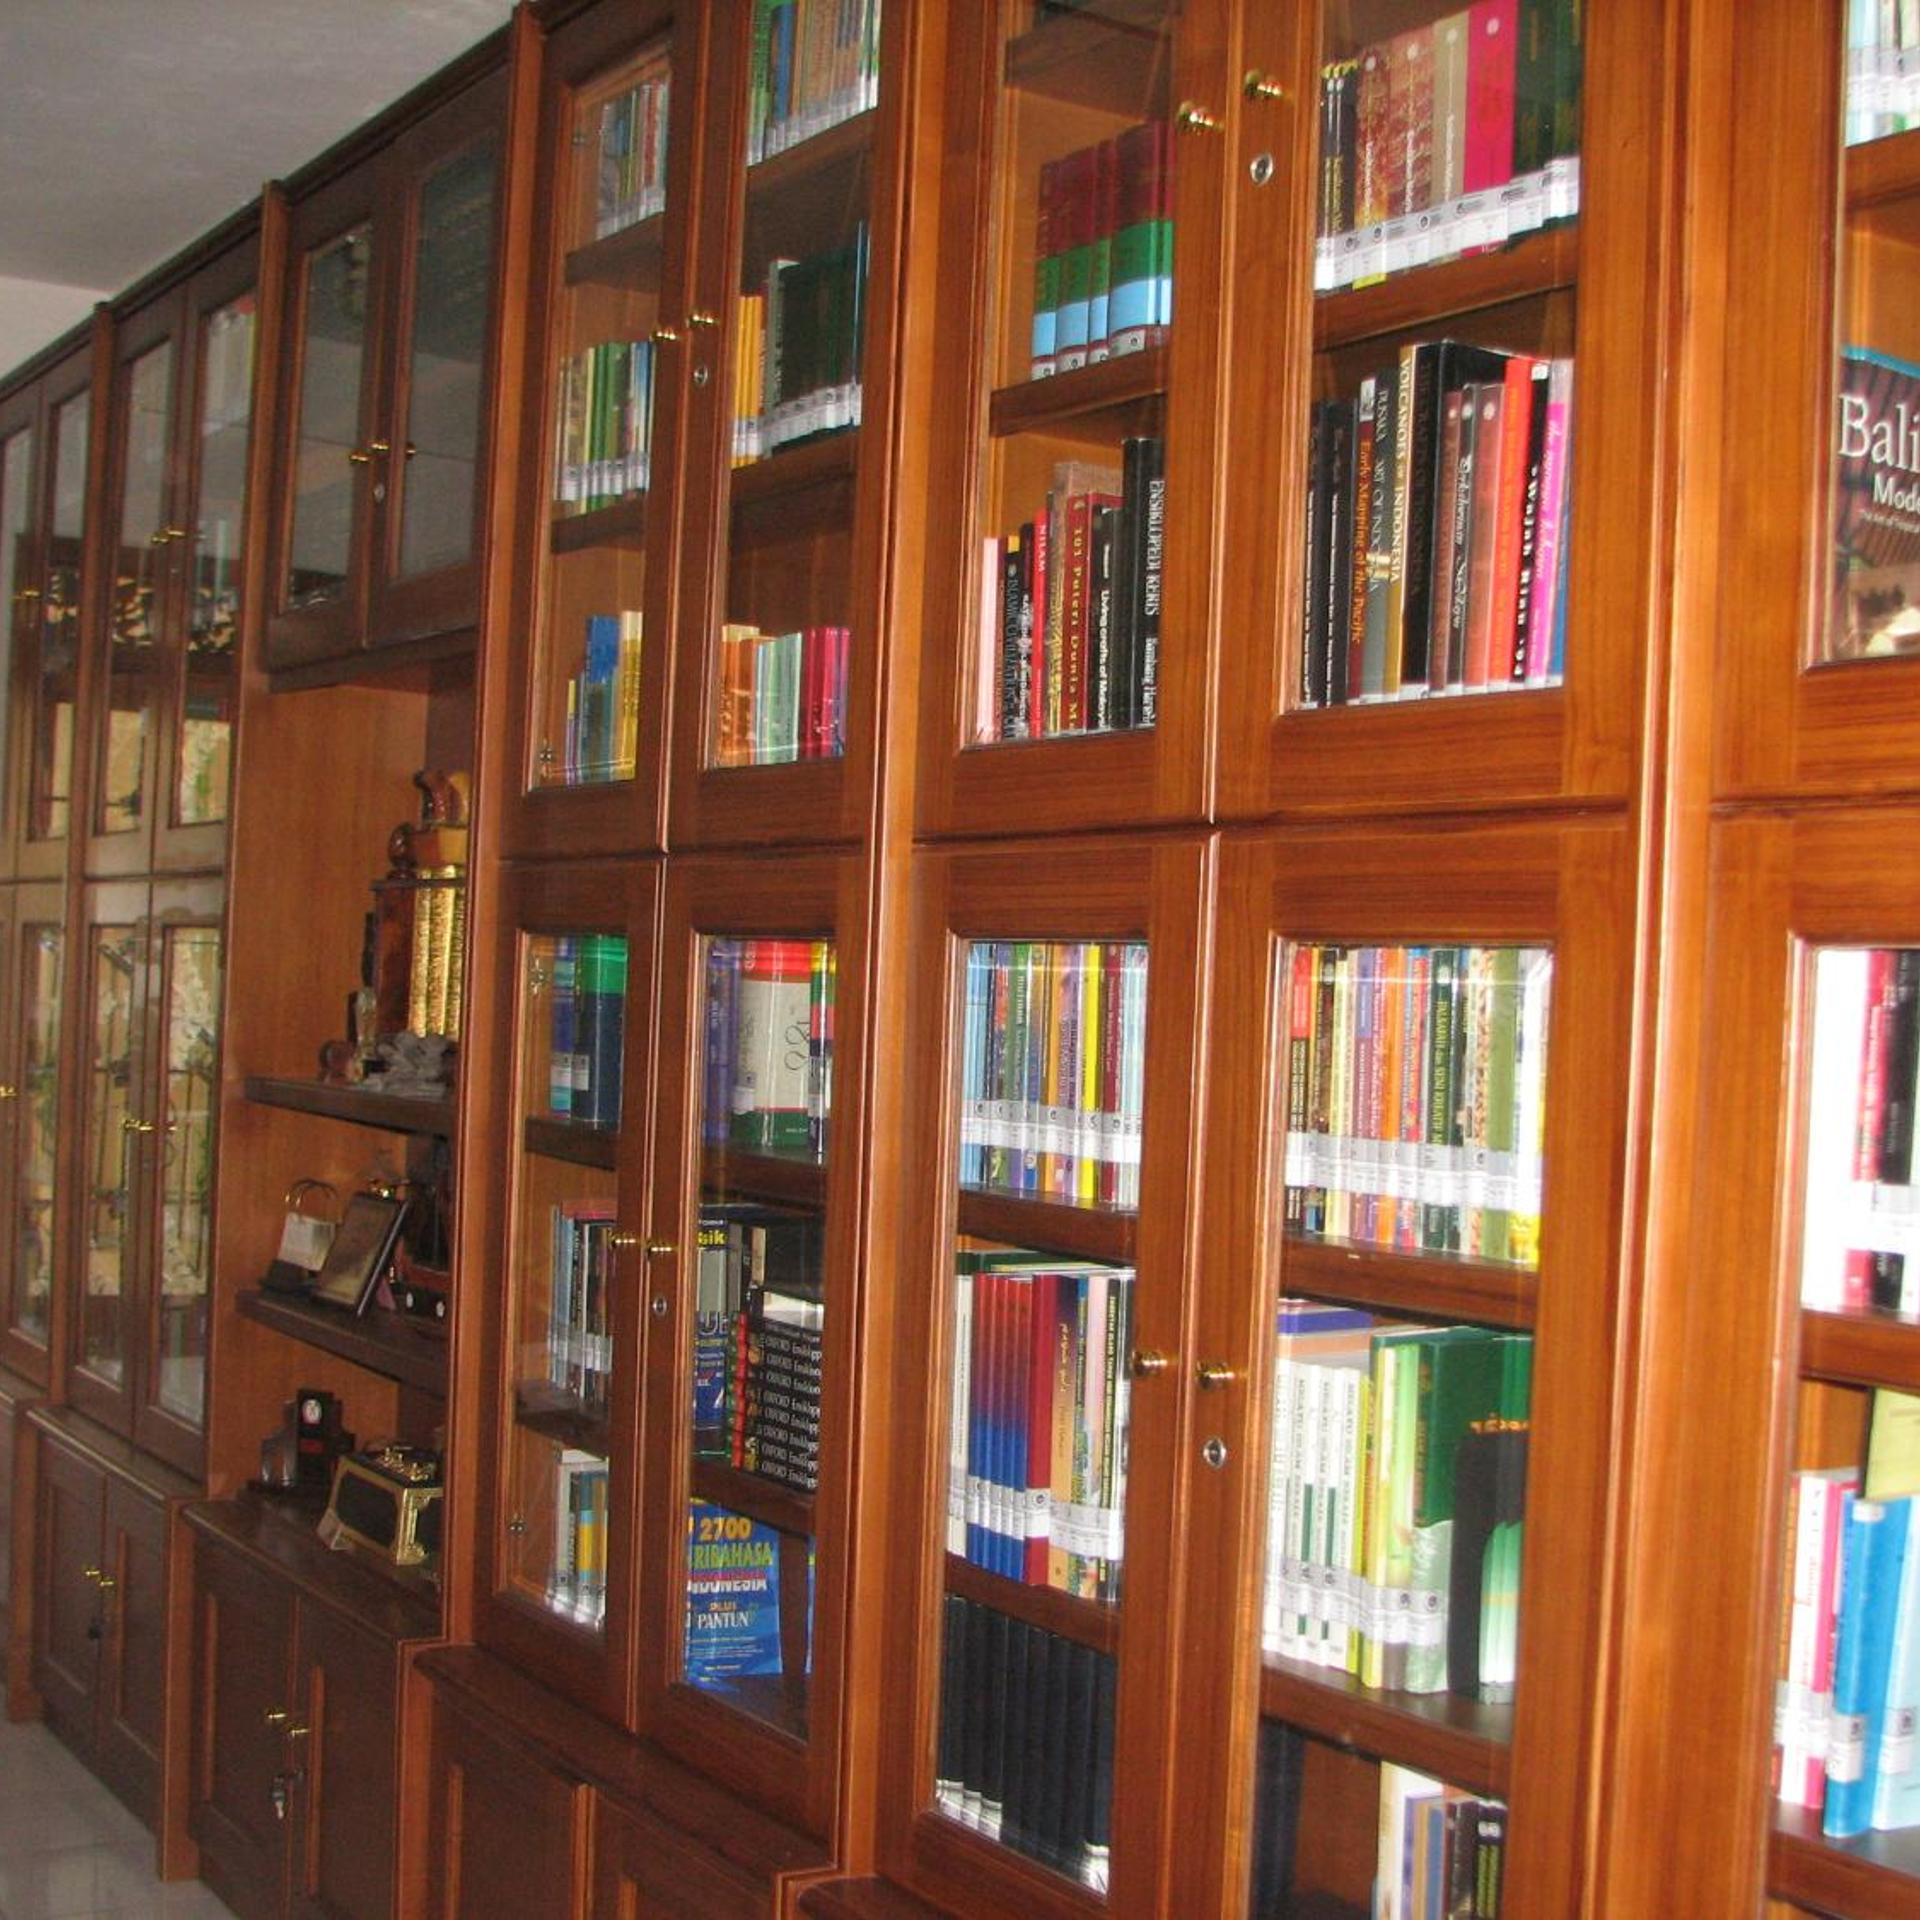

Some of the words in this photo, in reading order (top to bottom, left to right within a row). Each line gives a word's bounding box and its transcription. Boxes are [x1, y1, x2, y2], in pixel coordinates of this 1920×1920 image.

[1396, 357, 1411, 460] VOLCANOES
[1838, 393, 1920, 474] Bali
[1357, 441, 1372, 482] Early
[1148, 480, 1166, 570] ENSIKLOPEDI
[1353, 482, 1371, 548] Mapping
[1390, 486, 1405, 583] INDONESIA
[1354, 550, 1367, 566] of
[1146, 574, 1161, 616] KERIS
[1353, 569, 1367, 595] the
[1099, 589, 1113, 626] Living
[1350, 598, 1365, 645] Pacific
[699, 1515, 752, 1542] 2700
[697, 1610, 749, 1630] PANTUN
